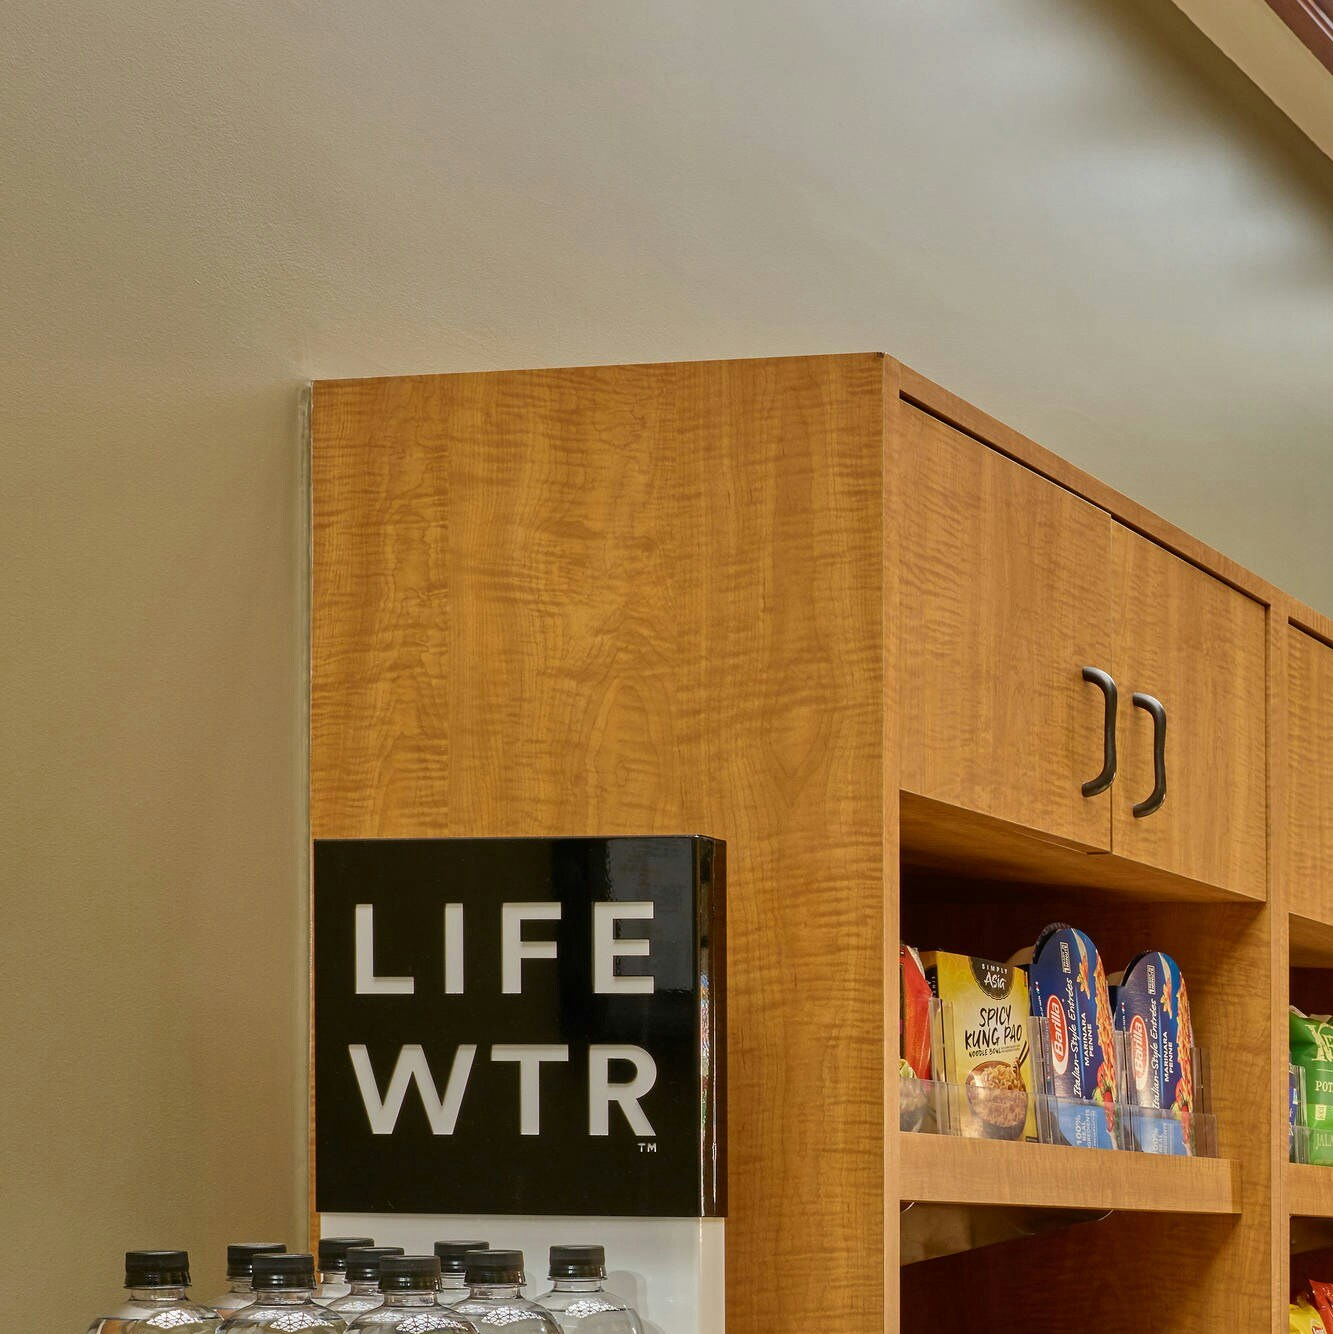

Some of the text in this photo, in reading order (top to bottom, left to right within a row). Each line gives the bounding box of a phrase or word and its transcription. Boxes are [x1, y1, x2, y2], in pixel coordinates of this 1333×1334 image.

[355, 902, 654, 994] LIFE
[981, 963, 1008, 974] SIMPLY
[984, 971, 1006, 990] Asia
[965, 1024, 1023, 1050] KUNG PAO
[979, 1004, 1011, 1028] SPICY
[1050, 1001, 1064, 1057] Barilla
[1081, 1012, 1090, 1067] MARINARA
[1086, 1023, 1094, 1058] PENNE
[1068, 1022, 1082, 1098] Italian-Style
[1134, 1021, 1143, 1075] Barilla
[348, 1044, 658, 1136] WTR
[1150, 1041, 1160, 1110] Italian-Style
